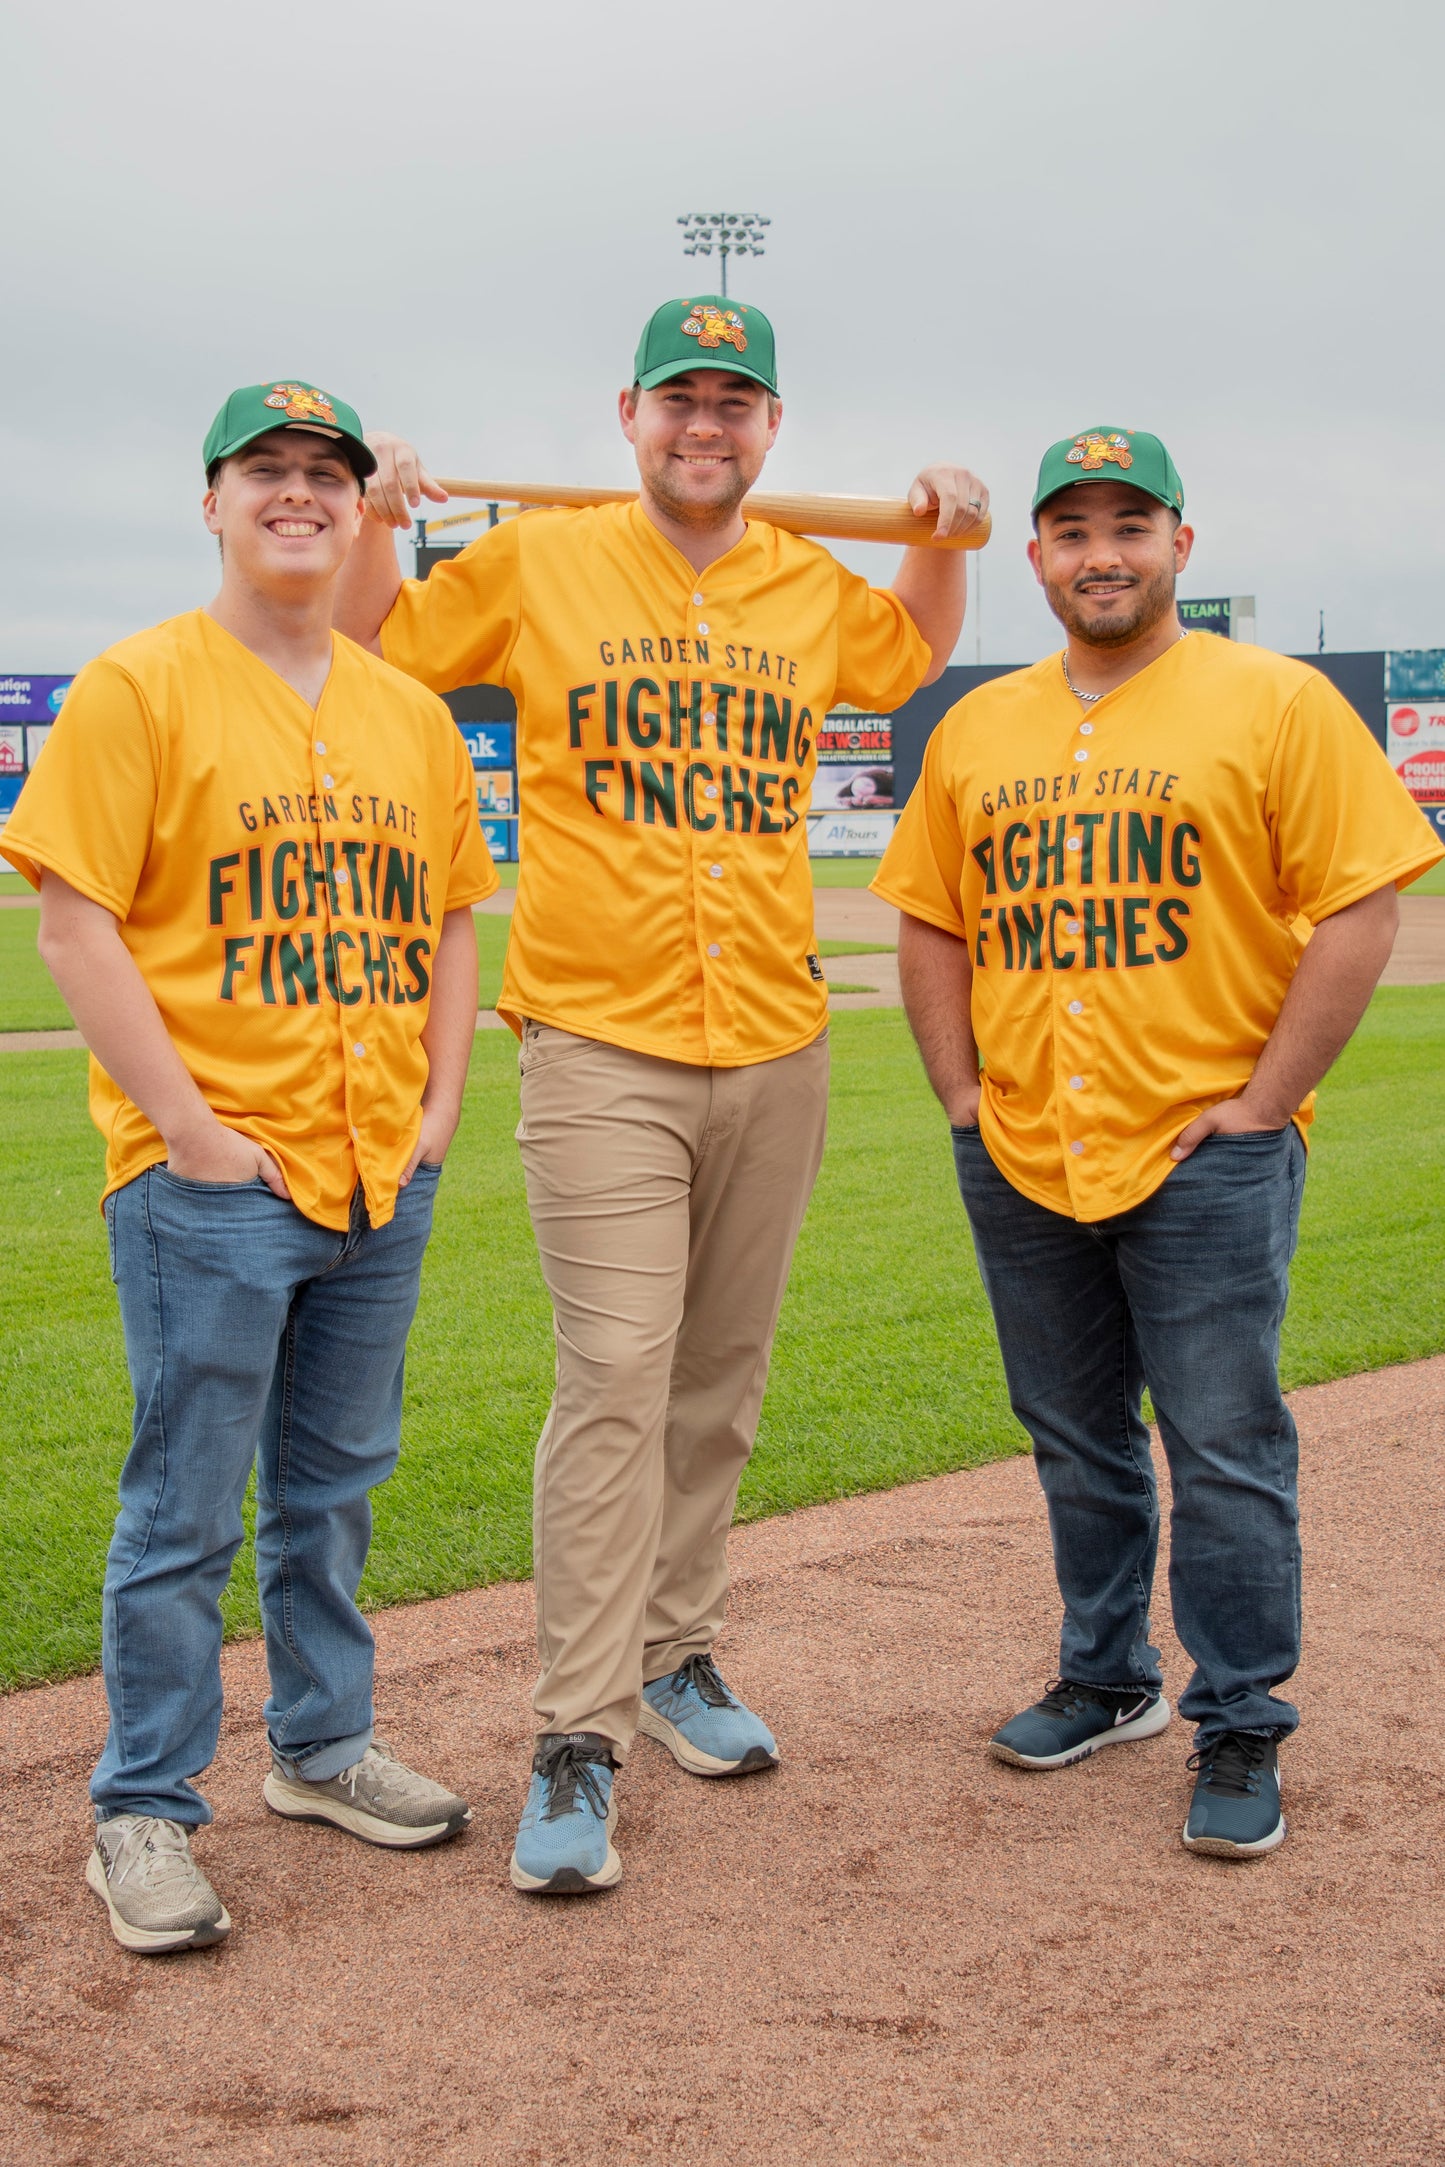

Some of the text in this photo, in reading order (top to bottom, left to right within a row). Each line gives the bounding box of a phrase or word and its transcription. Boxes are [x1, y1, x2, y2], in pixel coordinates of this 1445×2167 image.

[1181, 603, 1220, 618] TEAM
[599, 637, 798, 687] GARDEN STATE
[567, 676, 814, 769] FIGHTING
[239, 794, 417, 839] GARDEN STATE
[583, 759, 801, 834] FINCHES
[981, 768, 1179, 816] GARDEN STATE
[208, 839, 432, 928] FIGHTING
[218, 929, 431, 1006] FINCHES
[975, 896, 1191, 971] FINCHES
